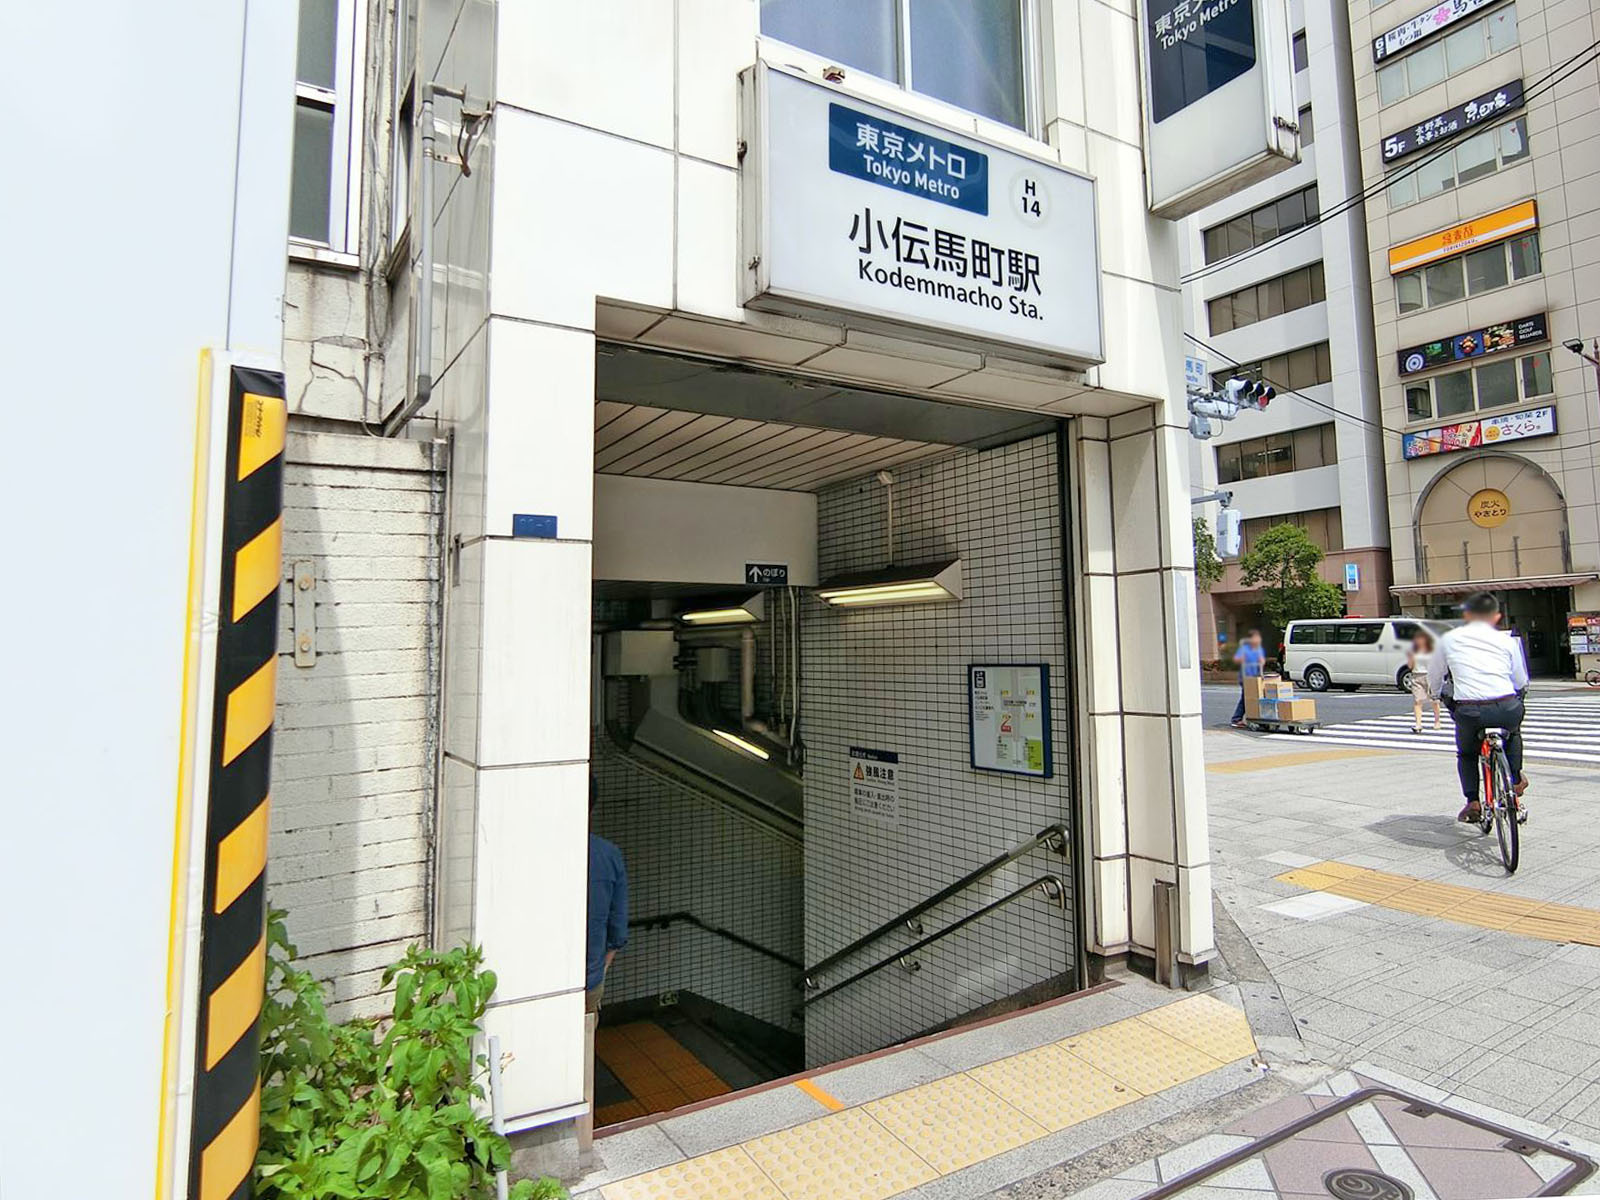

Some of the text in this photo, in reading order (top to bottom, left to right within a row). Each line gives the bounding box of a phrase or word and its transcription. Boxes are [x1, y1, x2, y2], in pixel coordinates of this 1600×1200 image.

[1161, 21, 1197, 50] Tokyo
[856, 122, 966, 179] 東京メトロ
[1384, 137, 1405, 158] 5F
[863, 153, 960, 199] Tokyo Metro
[1024, 179, 1036, 196] H
[1022, 197, 1041, 217] 14
[849, 207, 1042, 296] 小伝馬町駅
[858, 258, 1044, 320] Kodemmacho Sta.
[1536, 410, 1548, 418] 2F
[1501, 420, 1536, 435] さくら
[1475, 508, 1507, 518] やきとり
[762, 568, 786, 578] のぼり
